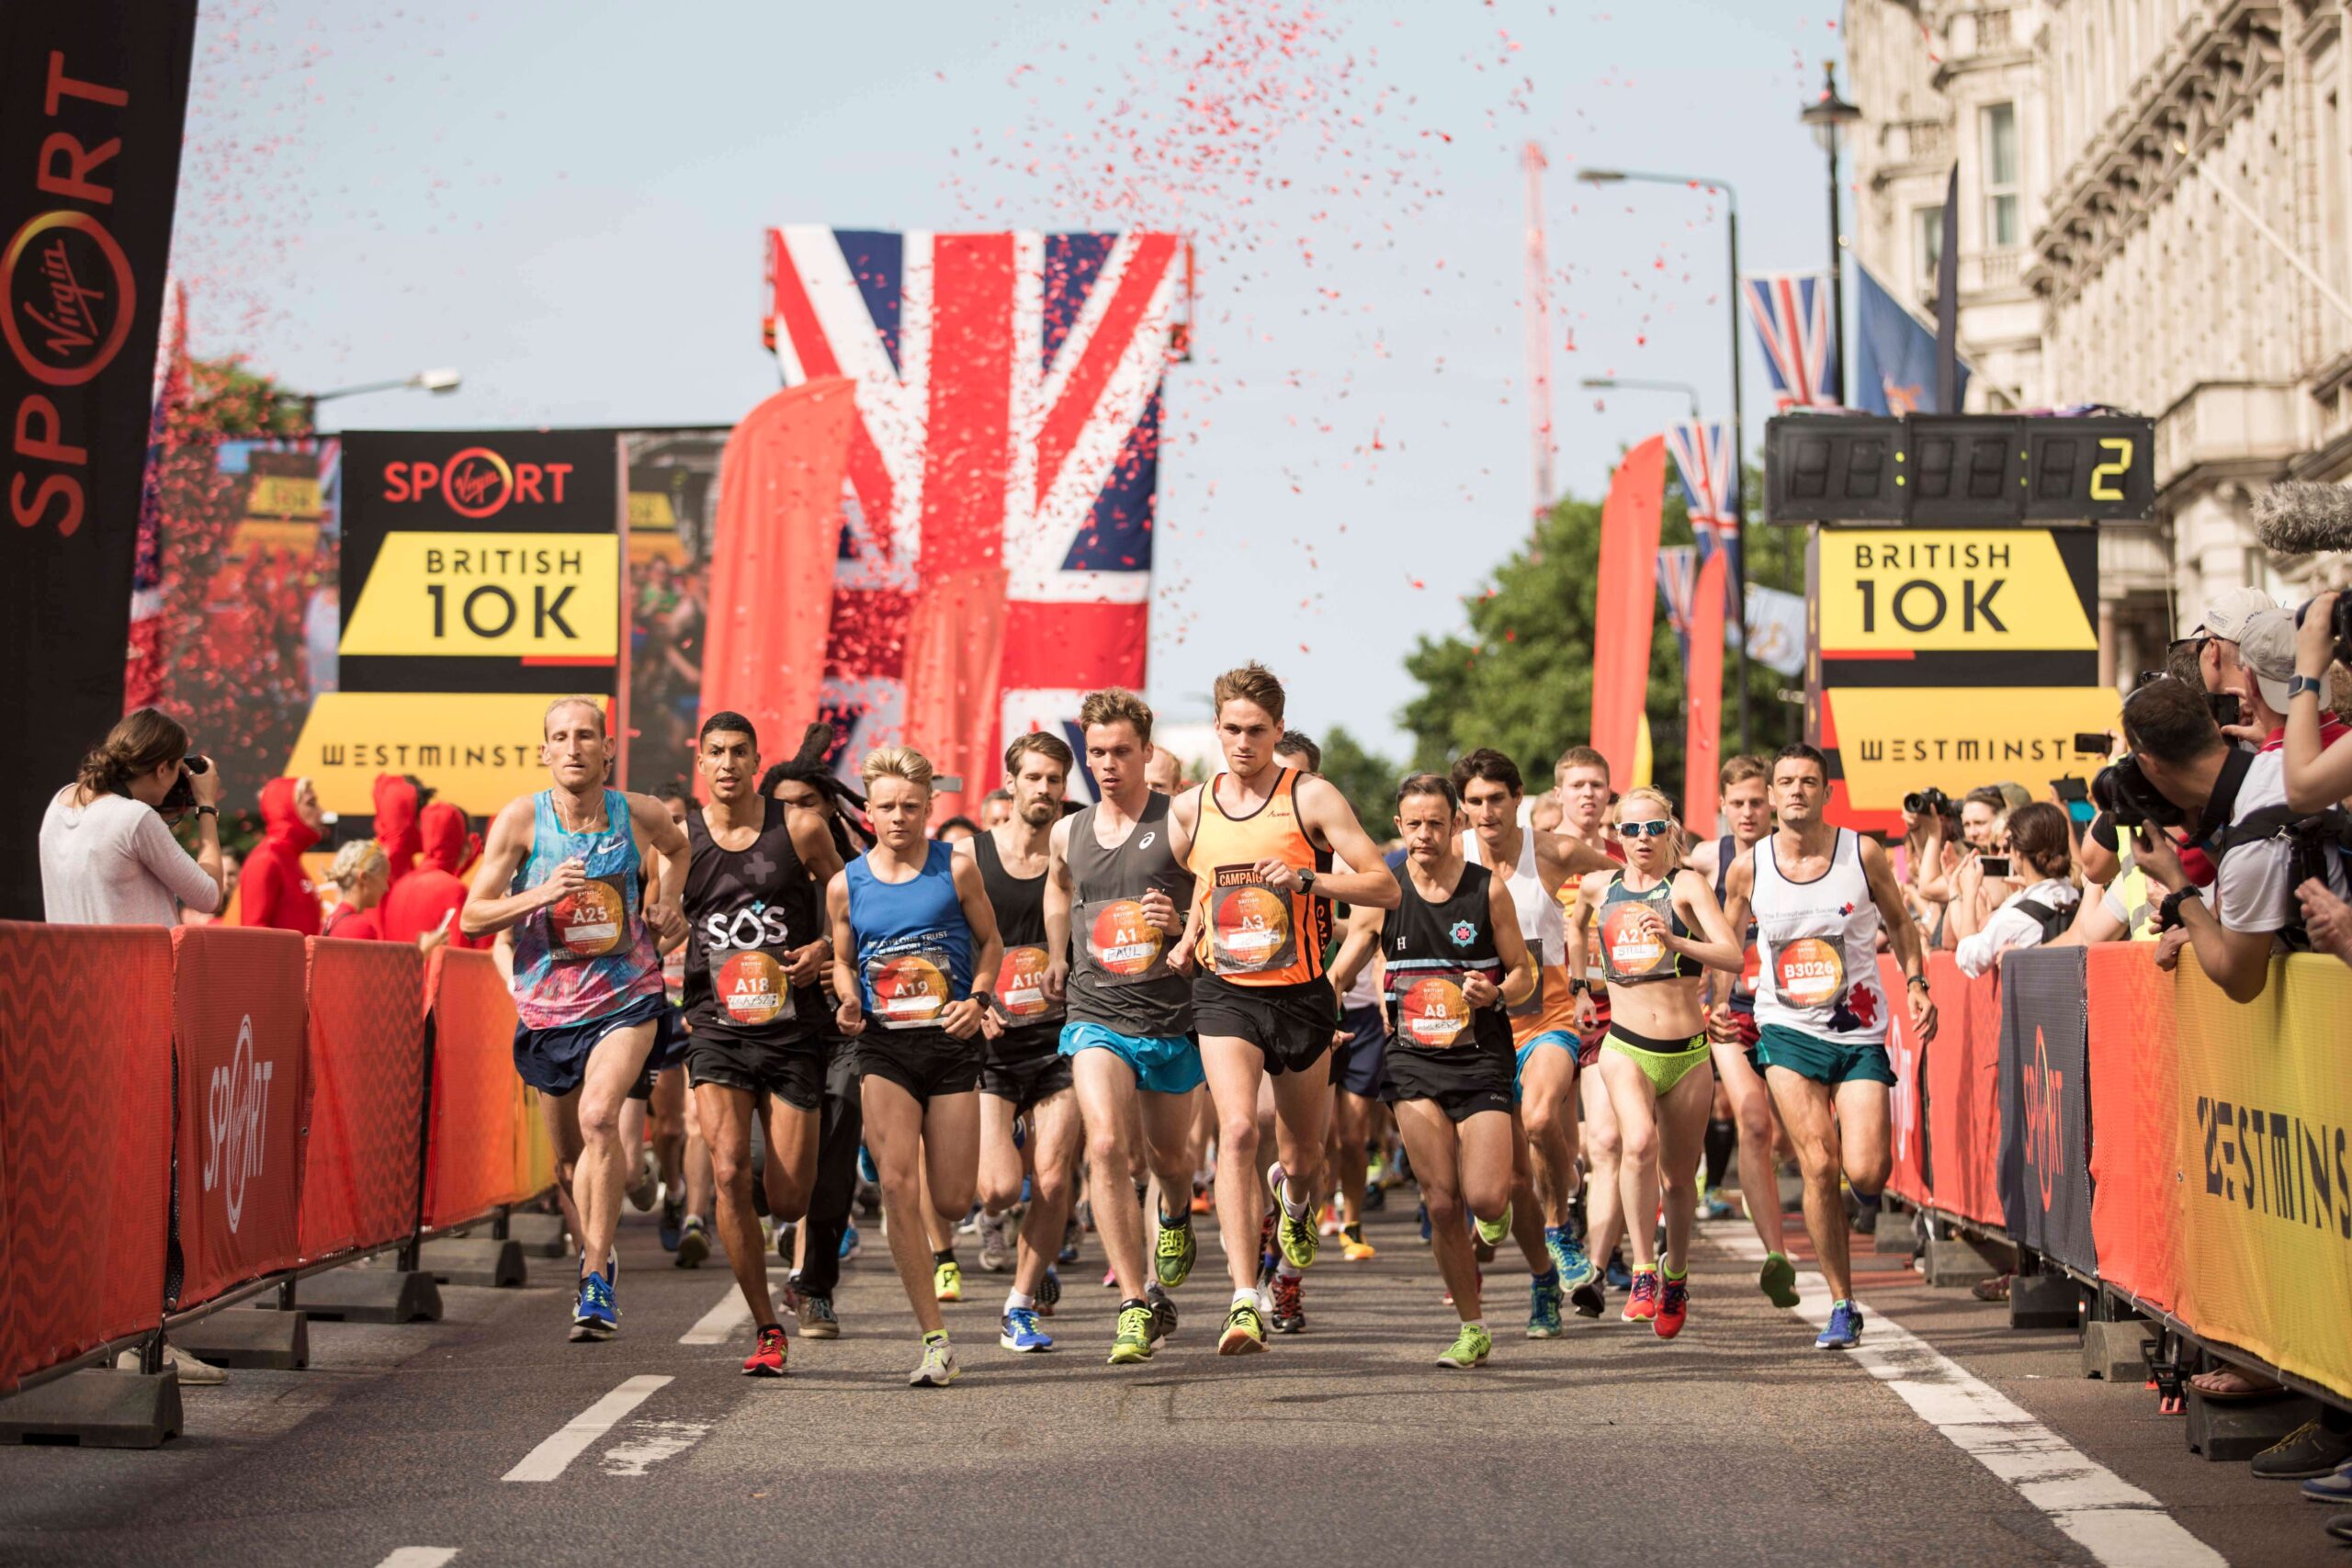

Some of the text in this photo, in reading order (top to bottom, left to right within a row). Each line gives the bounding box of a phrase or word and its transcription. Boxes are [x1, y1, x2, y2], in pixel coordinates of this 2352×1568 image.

[0, 51, 137, 537] SPORT
[25, 240, 105, 356] Virgin
[2089, 438, 2134, 502] 2
[383, 446, 573, 519] SPORT
[454, 461, 501, 504] Virgin
[426, 549, 582, 574] BRITISH
[1855, 543, 2010, 570] BRITISH
[427, 584, 579, 638] 10K
[1856, 579, 2008, 633] 10K
[322, 744, 547, 767] WESTMINSTE
[1860, 739, 2087, 761] WESTMINST
[572, 906, 608, 924] A25
[1242, 914, 1265, 930] A3
[707, 905, 789, 951] SOS
[922, 931, 948, 942] TRUST
[1114, 927, 1137, 944] A1
[1617, 929, 1648, 944] A21
[1396, 936, 1407, 951] H
[1012, 971, 1043, 989] A10
[1784, 960, 1836, 979] B3026
[735, 977, 769, 993] A18
[894, 980, 929, 997] A19
[1424, 1003, 1446, 1018] A8
[204, 1014, 273, 1235] SPORT
[2023, 1025, 2064, 1213] SPORT
